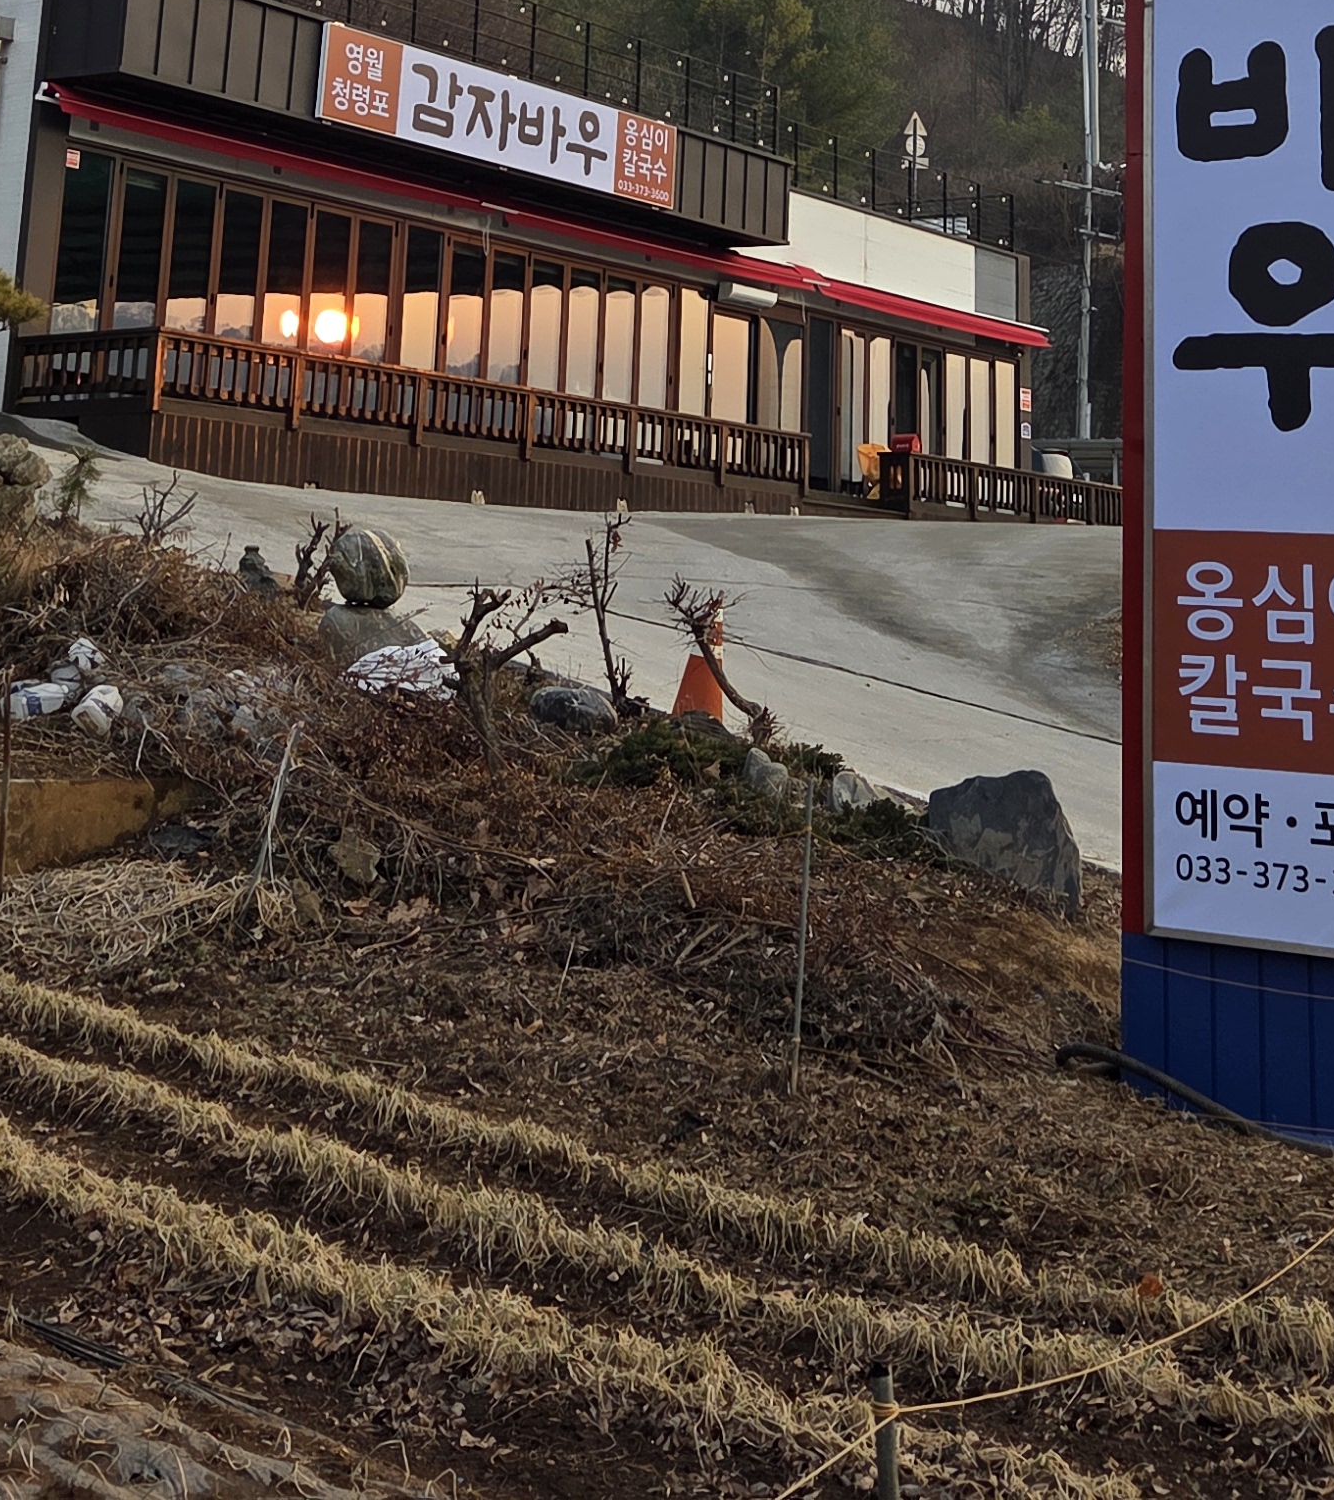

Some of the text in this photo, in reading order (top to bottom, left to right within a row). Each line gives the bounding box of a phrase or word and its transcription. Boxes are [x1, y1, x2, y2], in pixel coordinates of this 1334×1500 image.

[343, 41, 385, 83] 영월
[330, 76, 390, 118] 청령포
[411, 62, 608, 176] 감자바우
[623, 118, 669, 155] 옹심이
[622, 148, 668, 185] 칼국수
[617, 179, 670, 202] 033-373-3600
